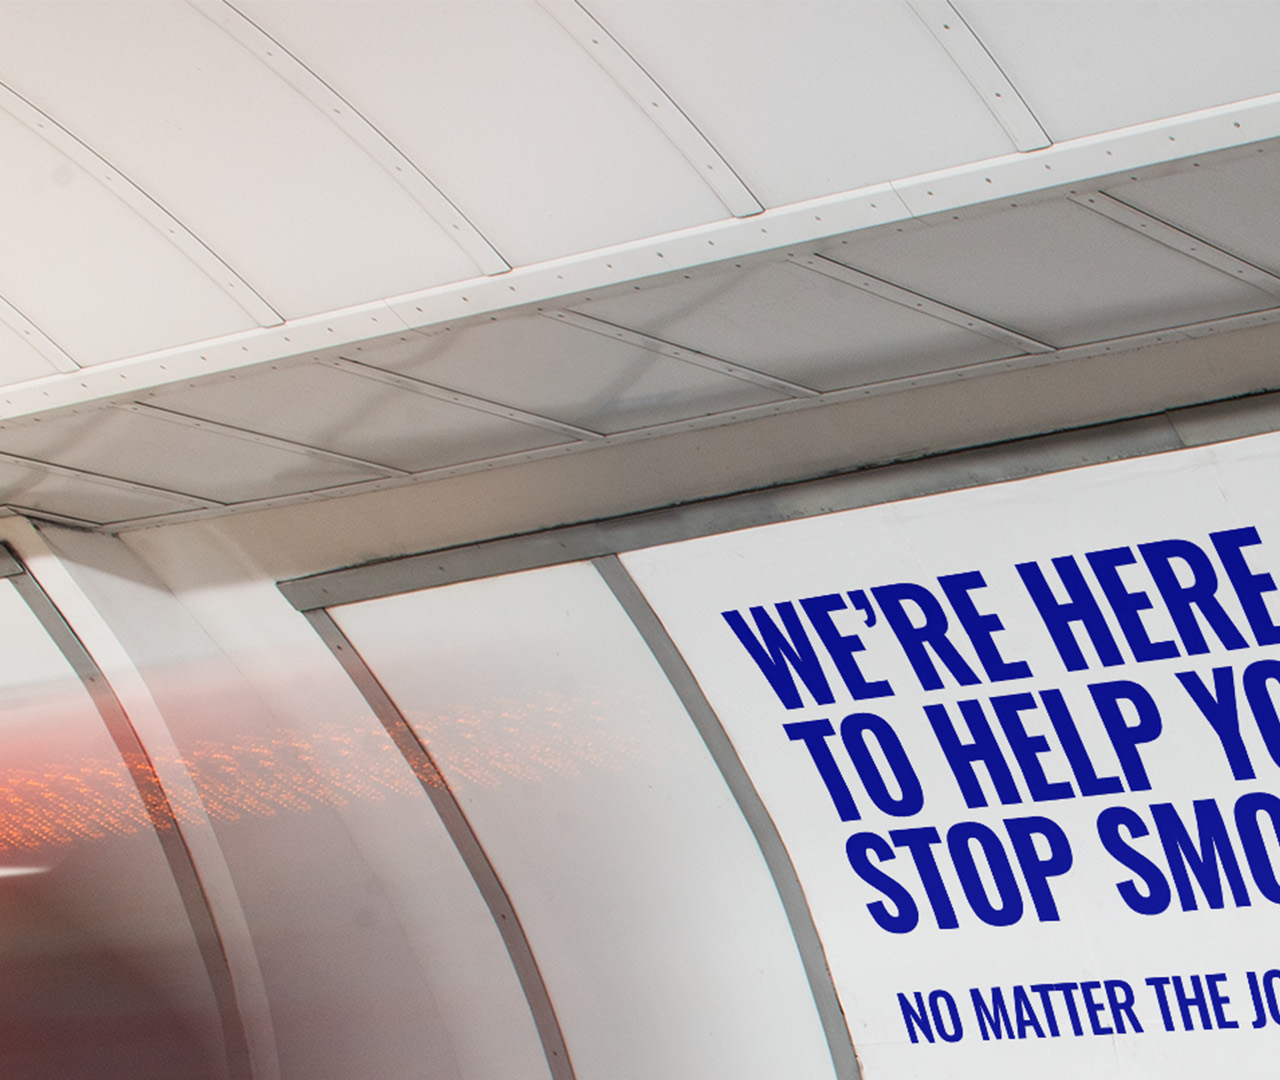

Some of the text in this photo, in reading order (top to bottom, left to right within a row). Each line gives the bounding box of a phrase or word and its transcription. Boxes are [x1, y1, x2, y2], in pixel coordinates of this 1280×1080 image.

[720, 569, 1033, 711] WE’RE
[782, 712, 925, 823] TO
[922, 679, 1164, 810] HELP
[845, 815, 1074, 935] STOP
[896, 989, 964, 1044] NO
[968, 979, 1145, 1042] MATTER
[1145, 972, 1240, 1032] THE
